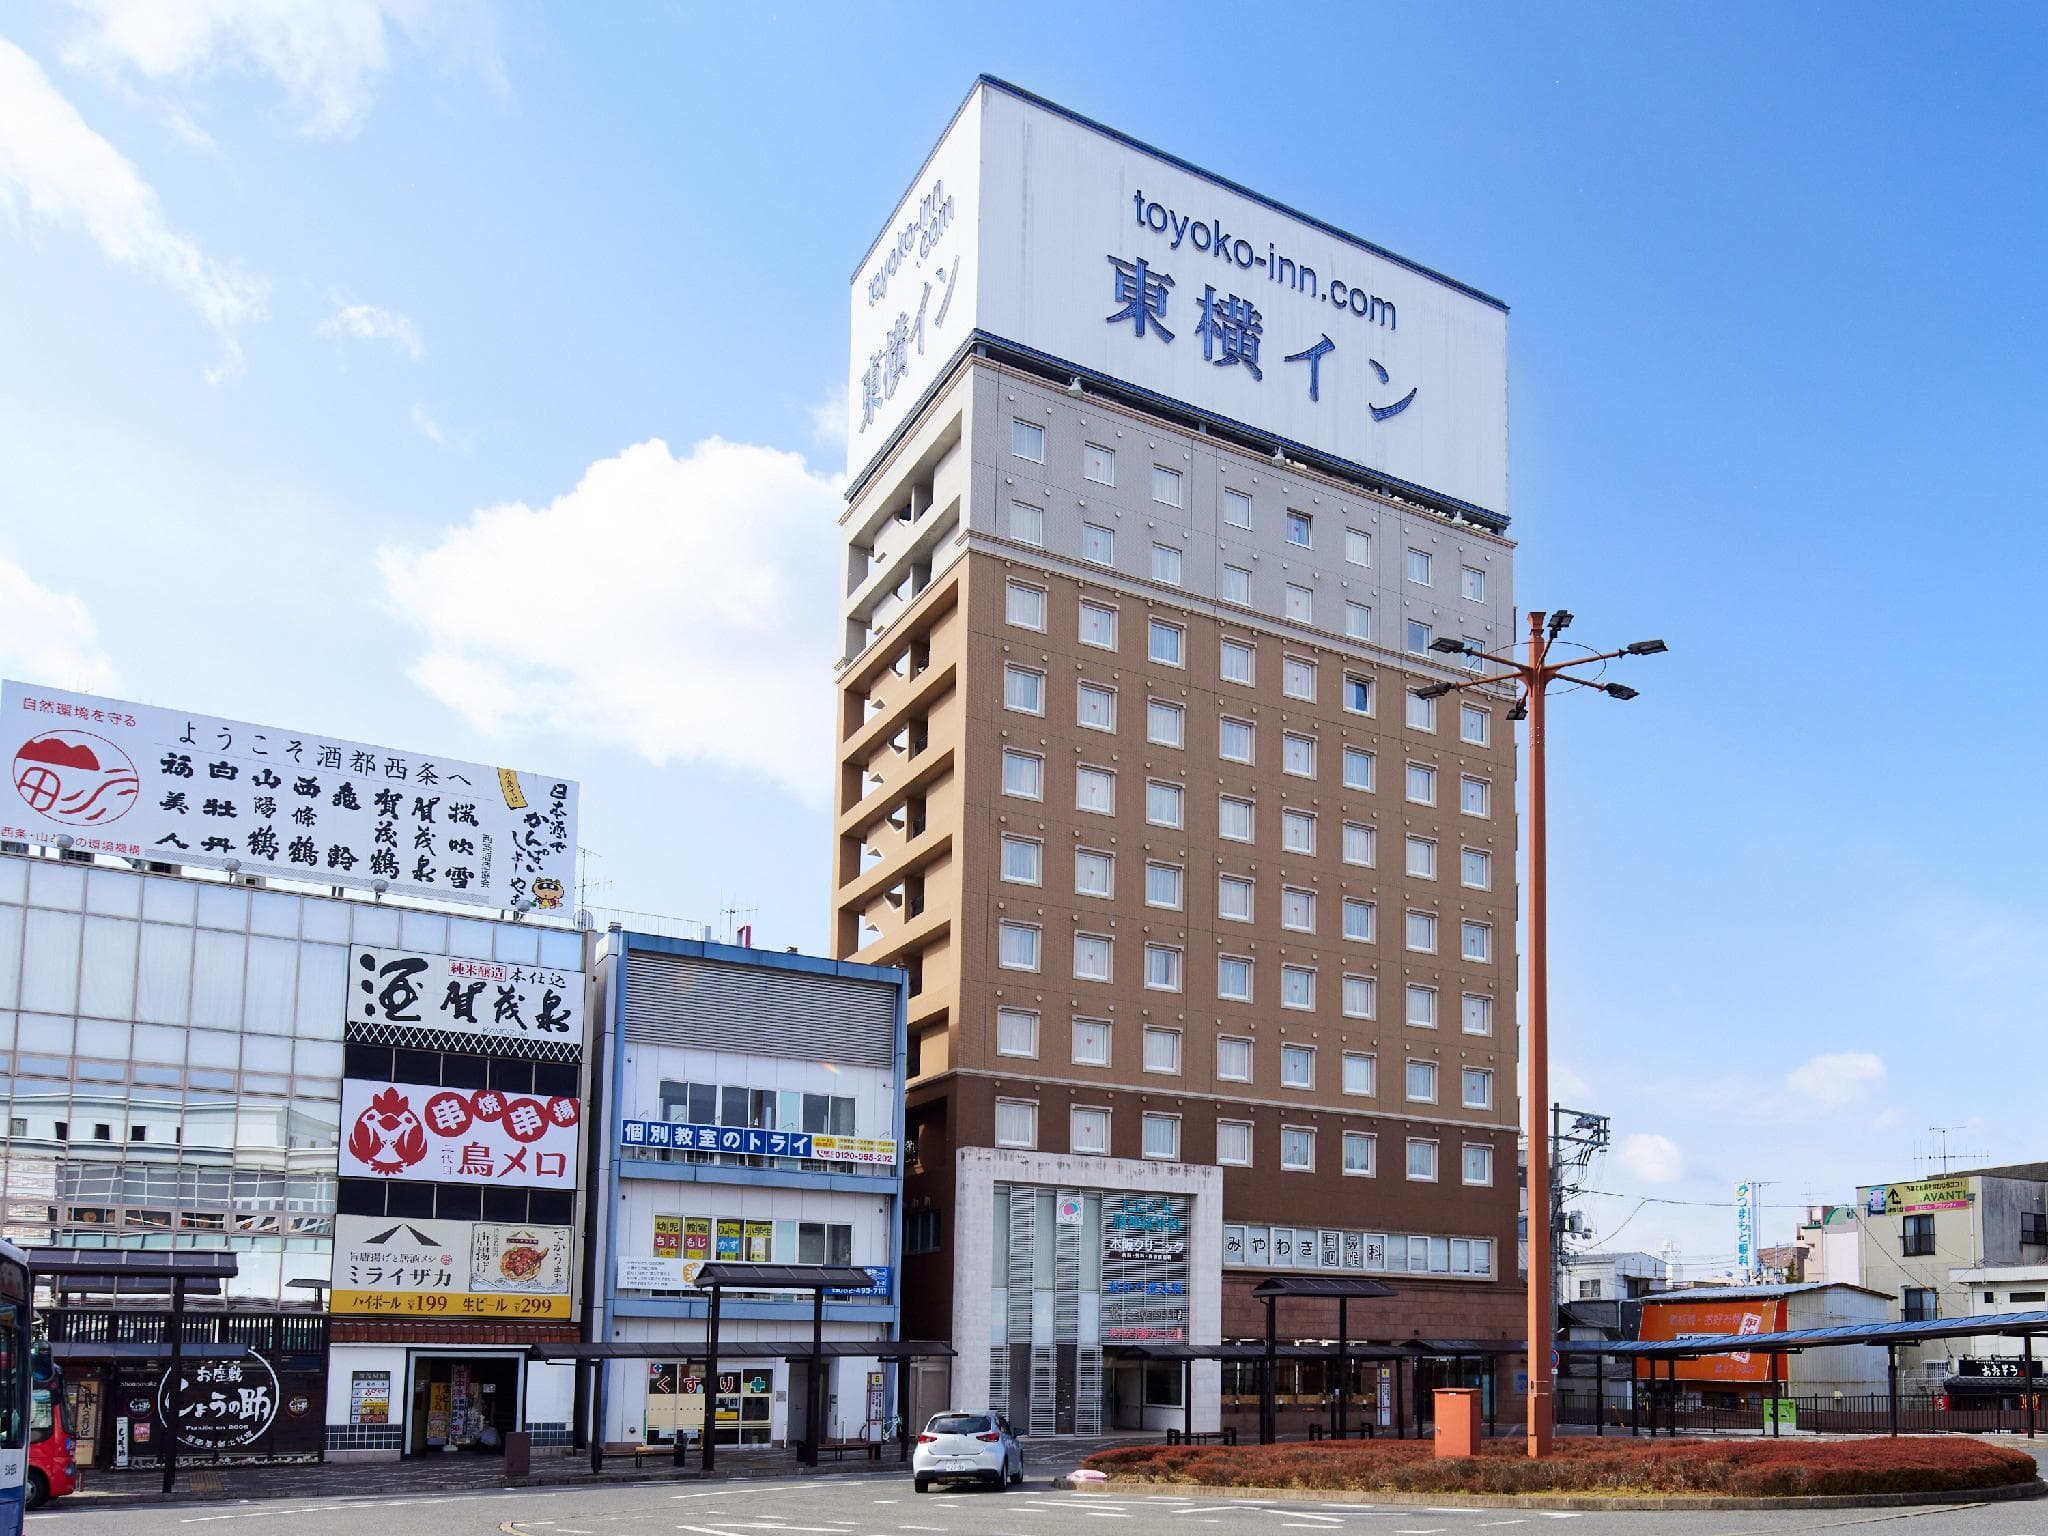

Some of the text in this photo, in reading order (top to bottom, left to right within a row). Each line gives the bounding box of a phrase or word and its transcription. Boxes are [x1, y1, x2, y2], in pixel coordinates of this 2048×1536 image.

[1133, 189, 1397, 331] toyoko-inn.com
[858, 254, 960, 434] 東横イン
[1105, 254, 1418, 423] 東横イン
[22, 696, 137, 728] 自然環境を守る
[179, 721, 472, 788] ようこそ酒都西条へ
[523, 811, 550, 873] かんぱい
[509, 967, 567, 988] 本仕込
[440, 980, 571, 1033] 賀茂泉
[624, 1122, 809, 1156] 個別教室のトライ
[457, 1141, 567, 1178] 鳥メロ
[349, 1265, 452, 1288] ミライザカ
[352, 1295, 401, 1310] ハイボール
[462, 1297, 507, 1313] 生ビール
[657, 1375, 734, 1394] くすり
